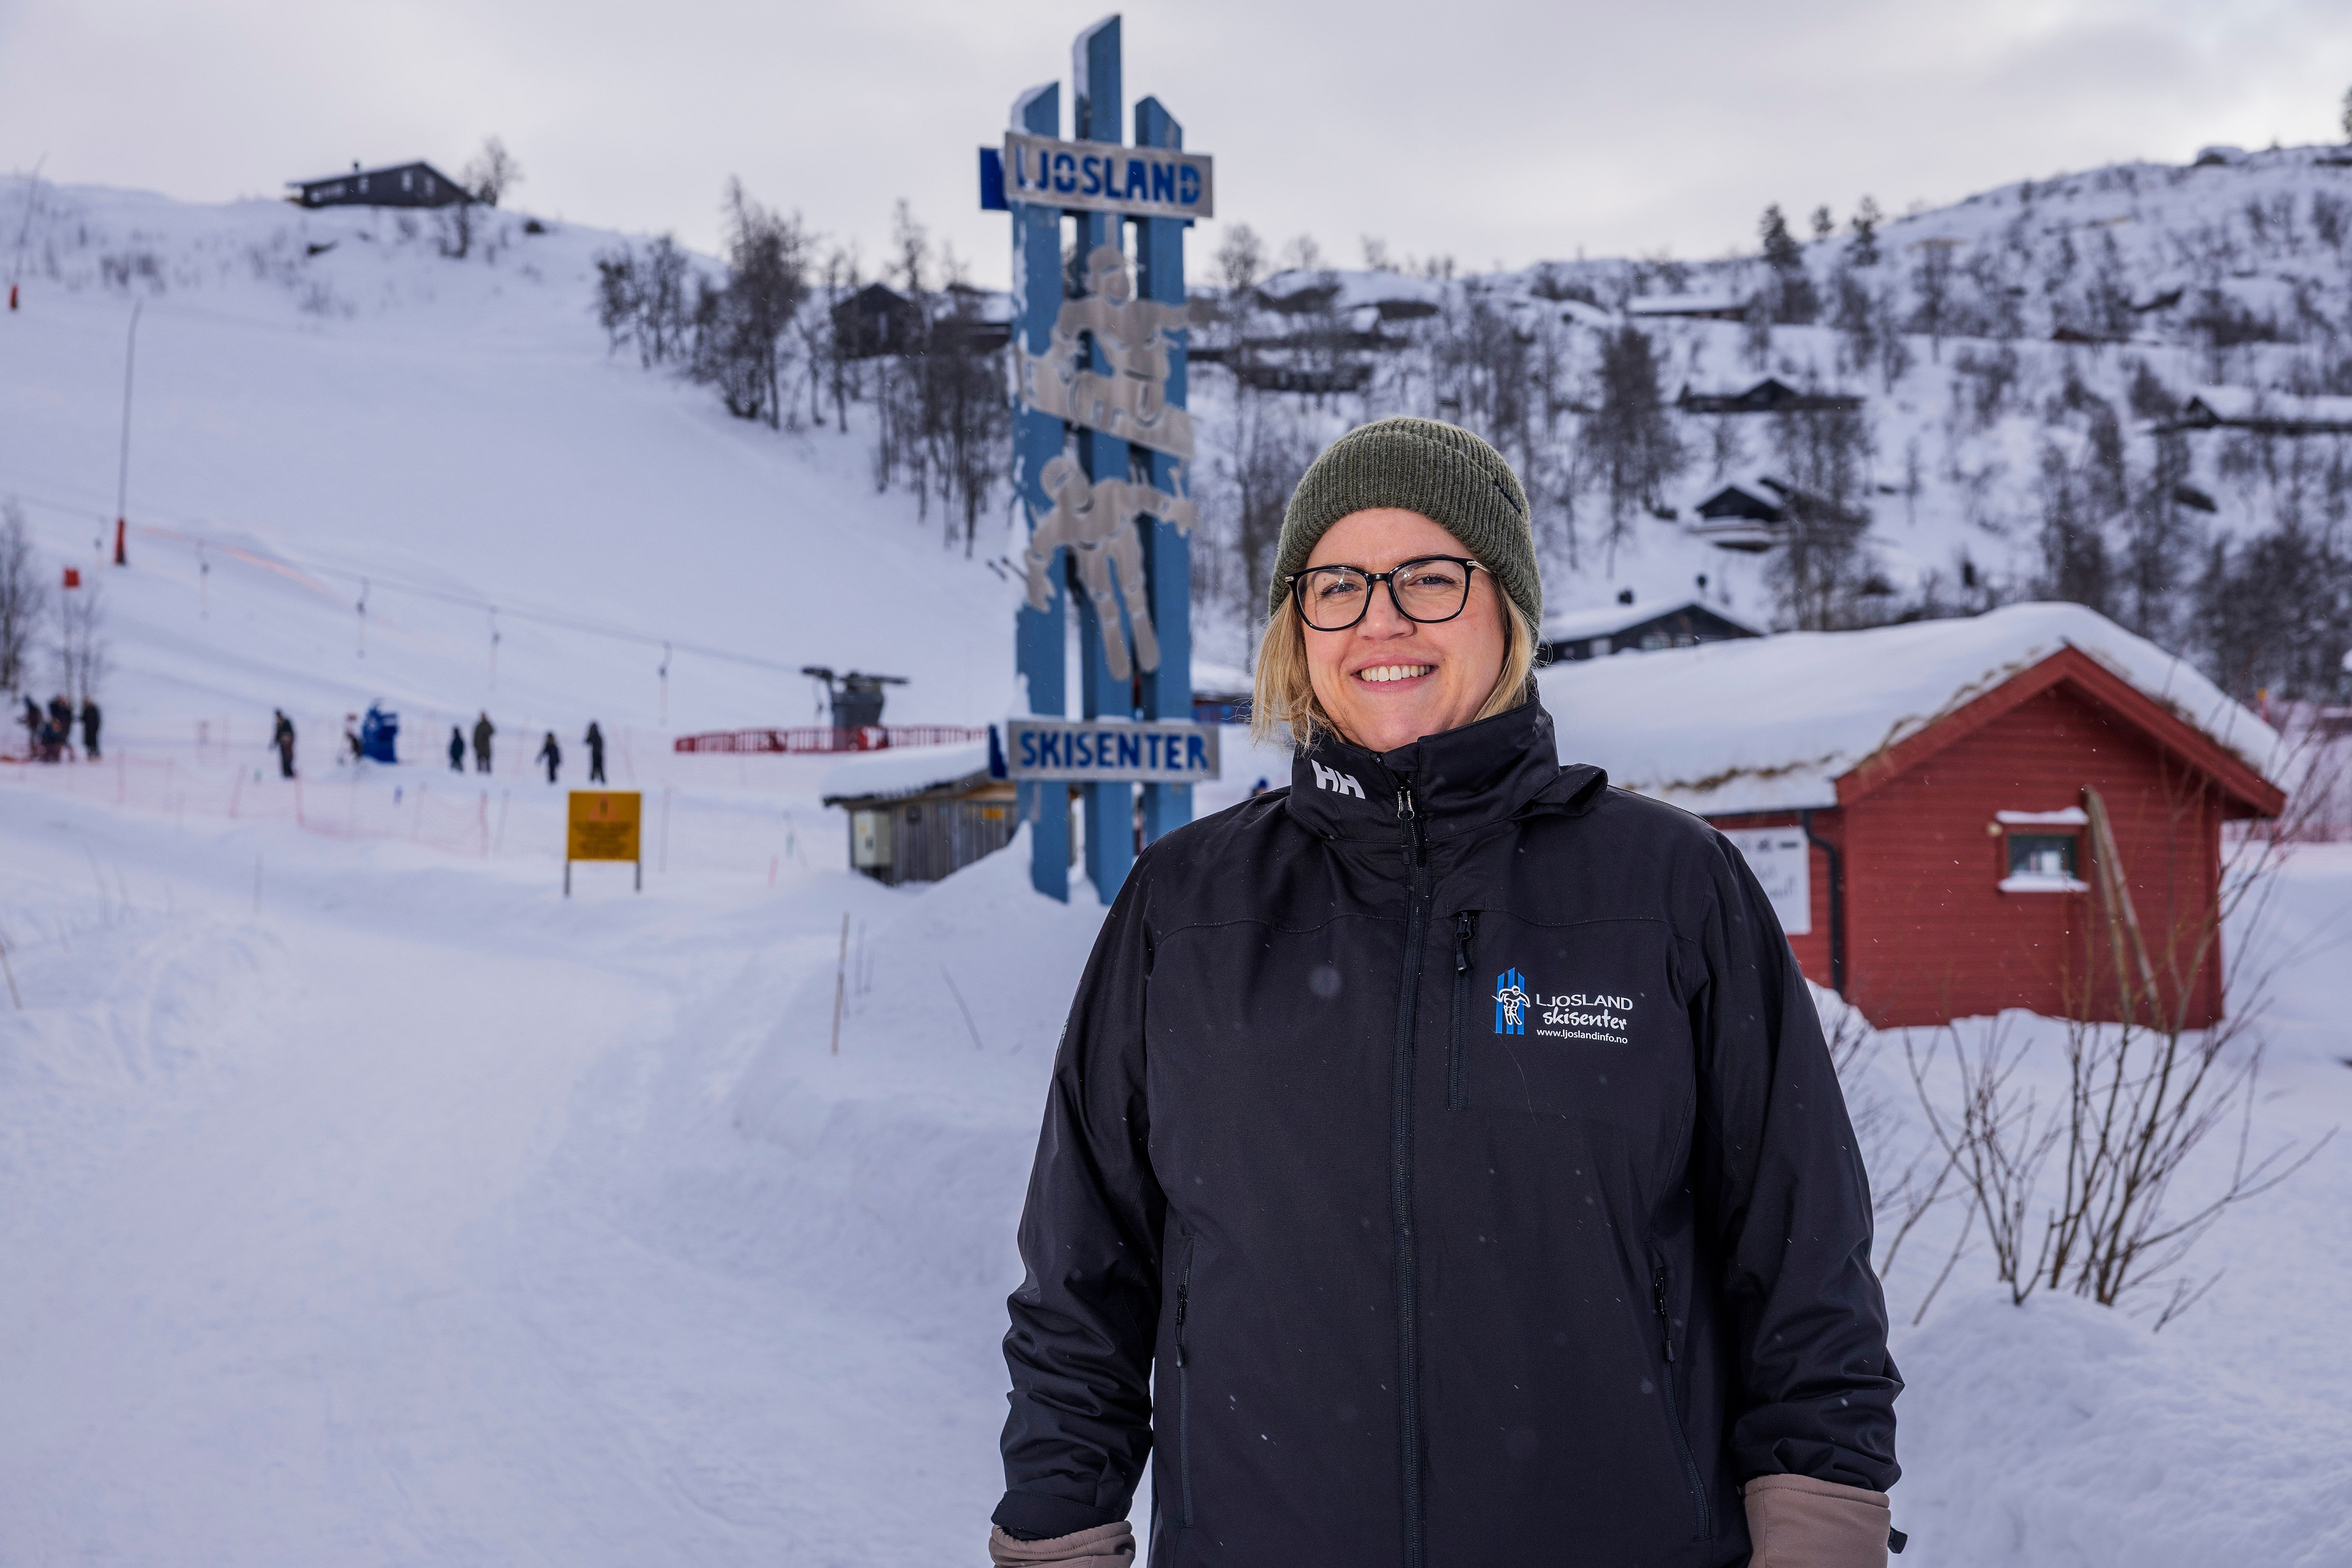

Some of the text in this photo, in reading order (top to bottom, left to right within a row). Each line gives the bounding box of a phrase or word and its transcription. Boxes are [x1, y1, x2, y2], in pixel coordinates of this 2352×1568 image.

[1020, 730, 1208, 769] SKISENTER
[1311, 759, 1365, 799] HH
[1536, 993, 1633, 1010] LJOSLAND
[1543, 1006, 1627, 1030] skisenter
[1537, 1029, 1628, 1044] www.ljoslandinfo.no
